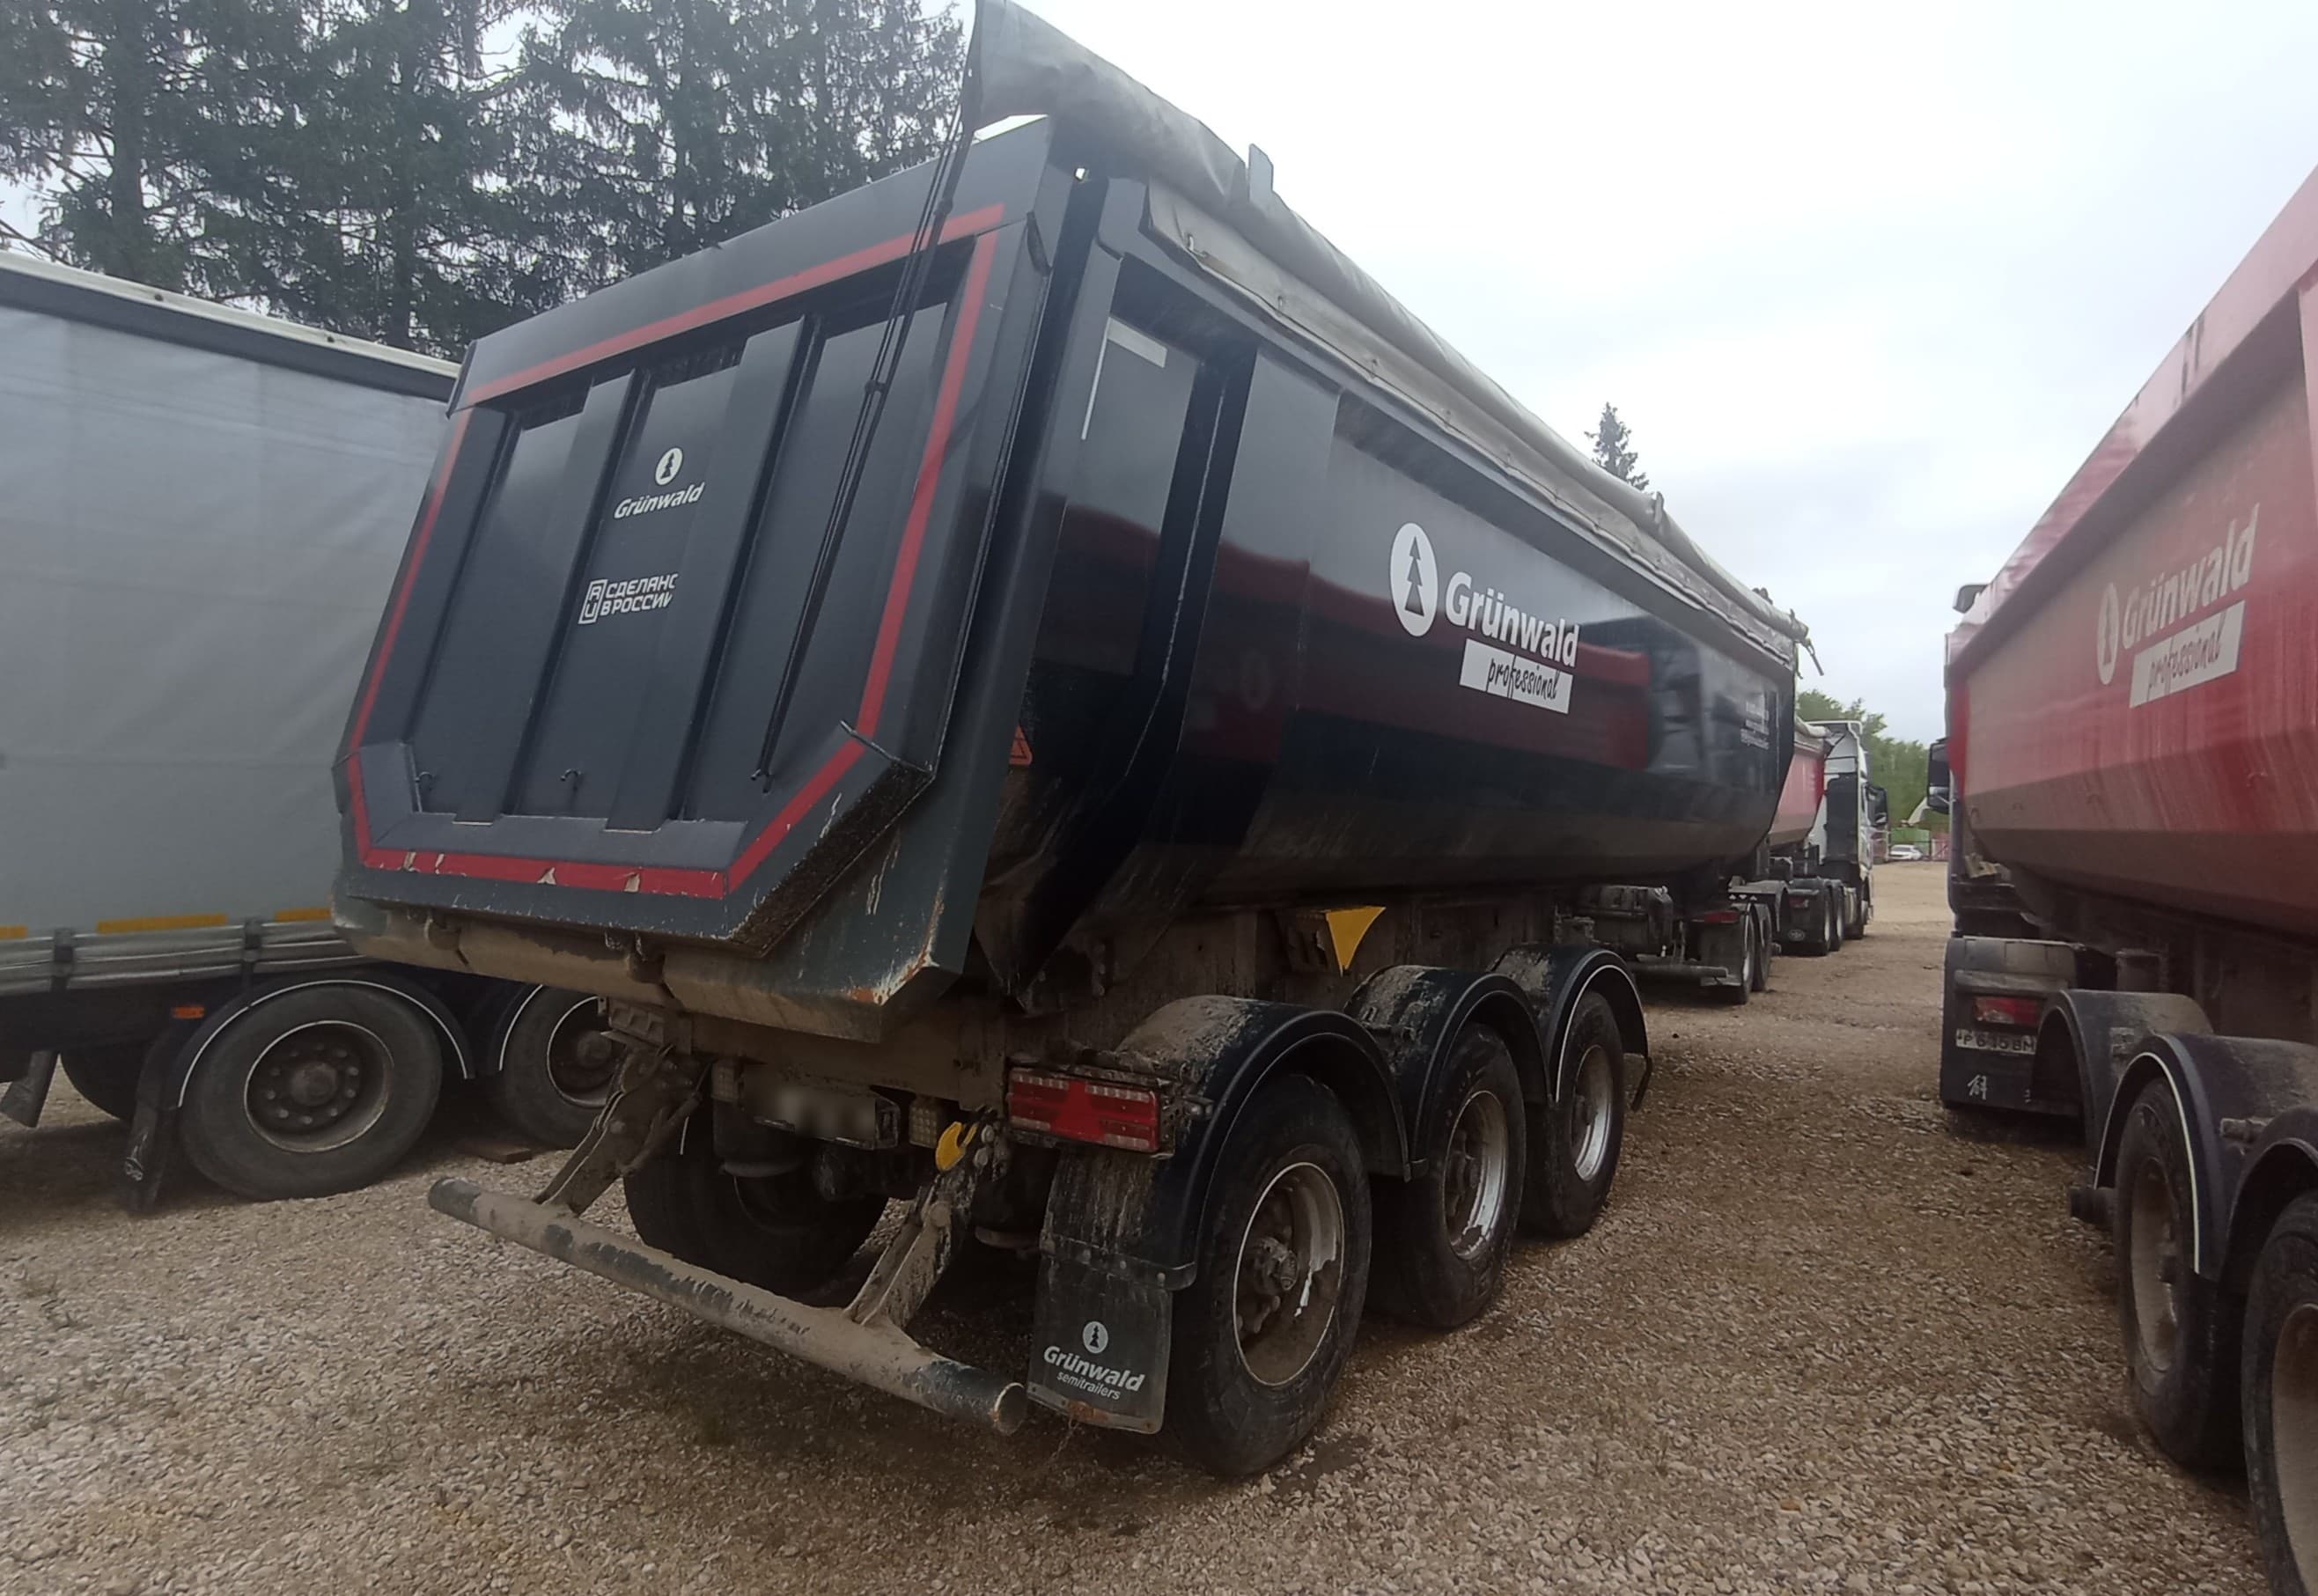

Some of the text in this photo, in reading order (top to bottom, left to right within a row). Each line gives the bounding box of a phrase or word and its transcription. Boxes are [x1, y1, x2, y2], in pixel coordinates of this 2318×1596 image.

[614, 482, 705, 519] Grünwald
[2123, 502, 2260, 650] Grünwald
[1446, 571, 1579, 667] Grünwald
[1485, 655, 1561, 701] professional
[1043, 1345, 1146, 1392] Grünwald
[1056, 1372, 1121, 1401] semitrailers
